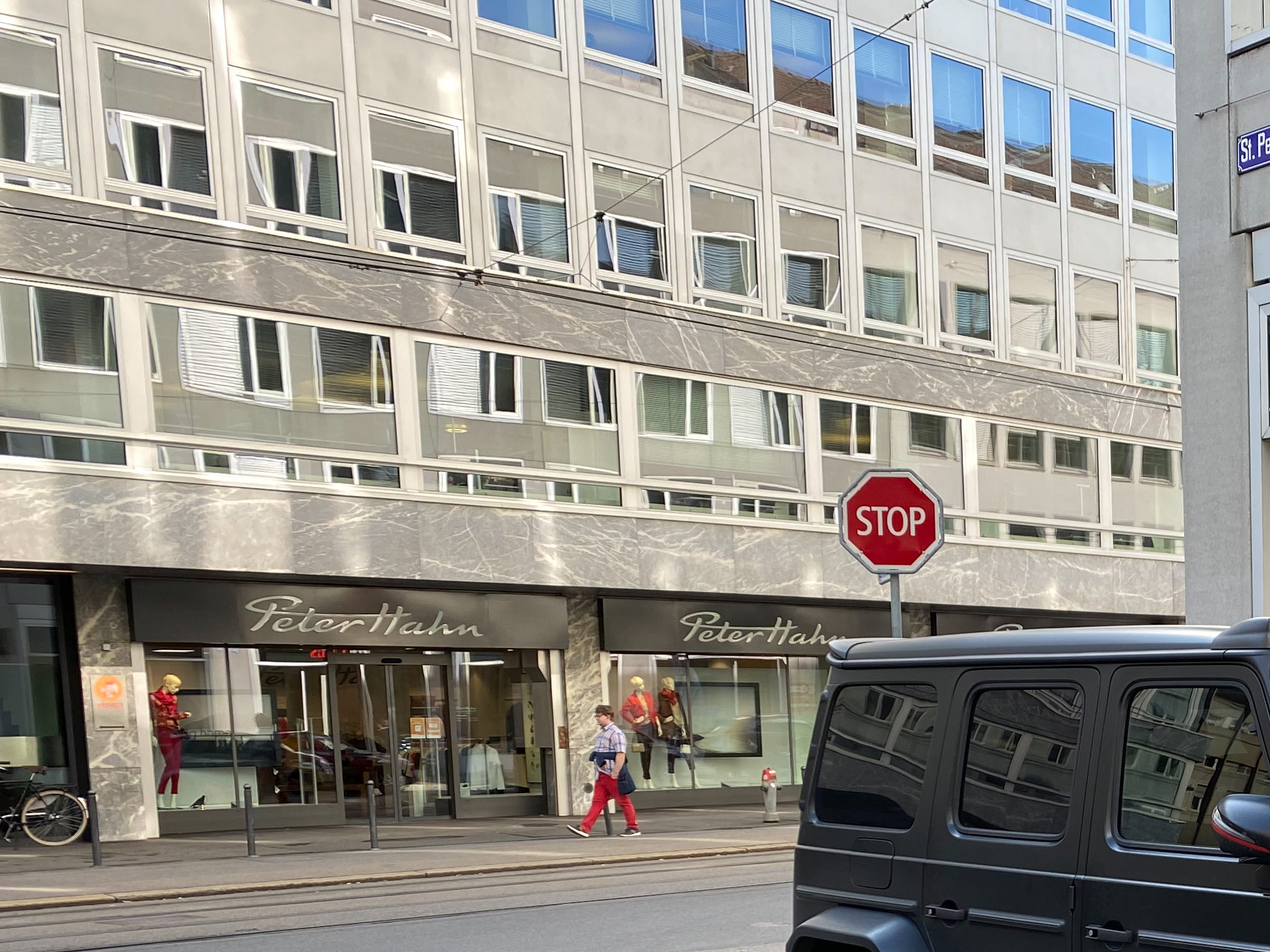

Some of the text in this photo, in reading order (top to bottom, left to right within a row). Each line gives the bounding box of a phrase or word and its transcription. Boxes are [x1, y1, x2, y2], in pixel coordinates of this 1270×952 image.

[1241, 138, 1255, 162] St.
[856, 505, 926, 537] STOP
[245, 595, 484, 637] Peter Hahn
[679, 611, 764, 643] Peter
